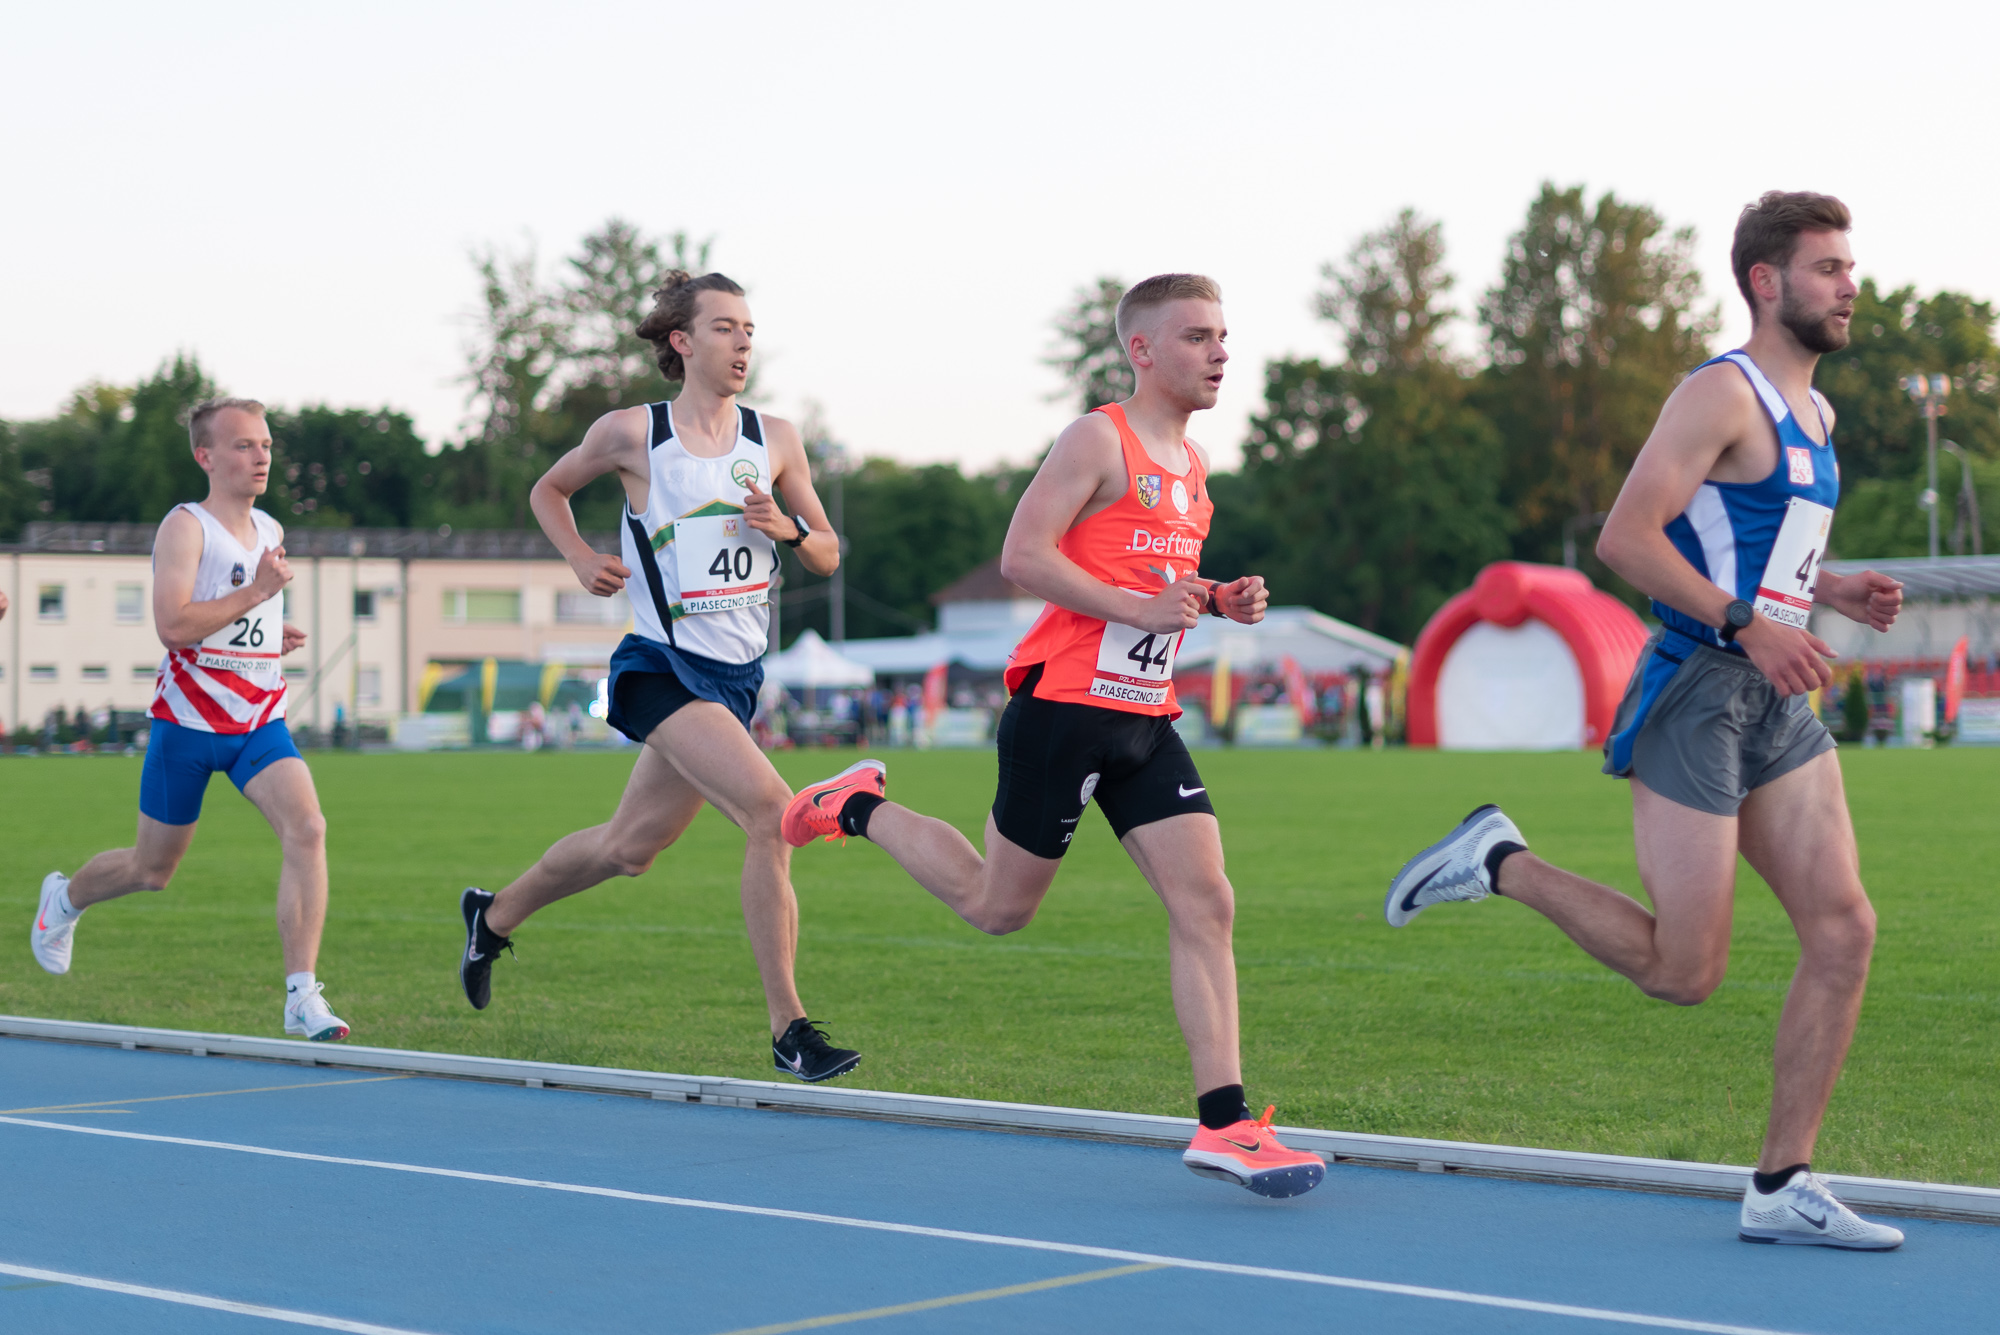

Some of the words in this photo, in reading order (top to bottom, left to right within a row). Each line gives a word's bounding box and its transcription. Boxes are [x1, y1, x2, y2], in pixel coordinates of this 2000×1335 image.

[735, 463, 755, 476] RKS
[708, 546, 752, 582] 40
[690, 596, 745, 611] PIASECZNO
[746, 594, 762, 605] 2021
[1762, 603, 1805, 626] PIASECZNO
[228, 617, 264, 648] 26
[204, 657, 253, 670] PIASECZNO
[255, 660, 271, 670] 2021
[1128, 633, 1172, 675] 44
[1119, 675, 1135, 684] PZLA
[1099, 683, 1153, 703] PIASECZNO
